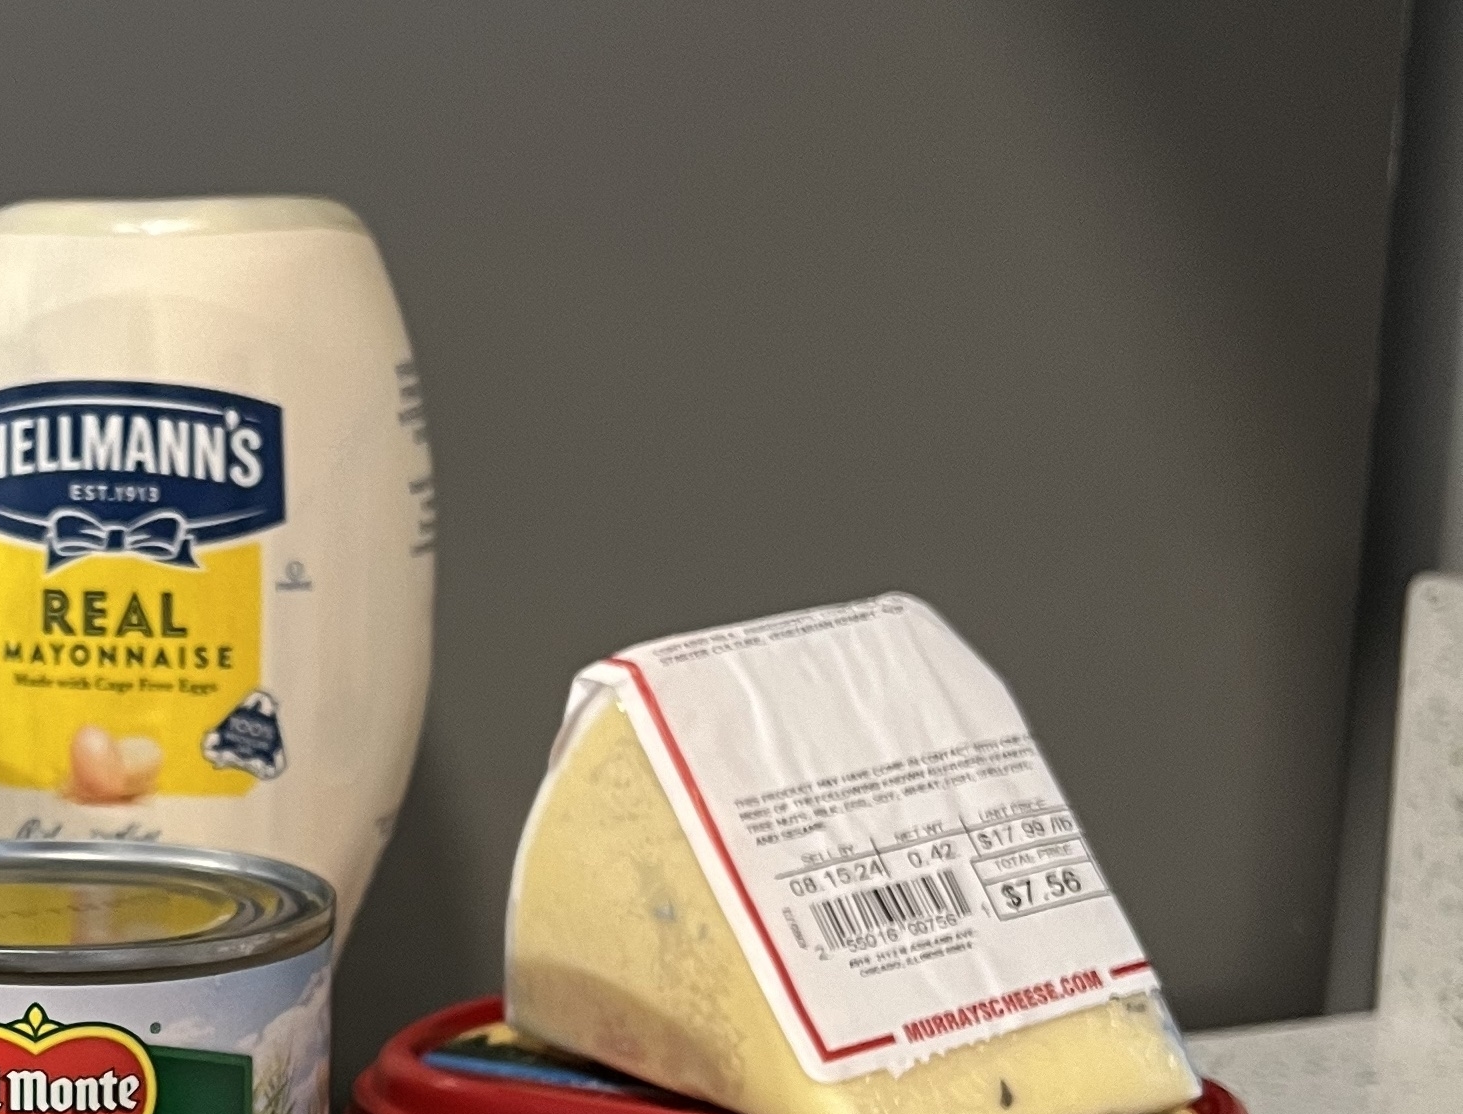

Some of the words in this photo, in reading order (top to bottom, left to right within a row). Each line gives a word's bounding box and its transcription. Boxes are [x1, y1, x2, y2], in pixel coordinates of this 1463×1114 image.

[43, 589, 188, 638] REAL
[4, 641, 233, 670] MAYONNAISE
[57, 676, 90, 690] with
[95, 678, 133, 694] Cage
[139, 679, 173, 692] Free
[179, 679, 218, 695] Eggs
[907, 842, 956, 868] 0.42
[994, 854, 1034, 871] TOTAL
[1001, 868, 1081, 912] $7.56
[902, 970, 1103, 1043] MURRAYSCHEESE.COM
[6, 1068, 140, 1113] Monte
